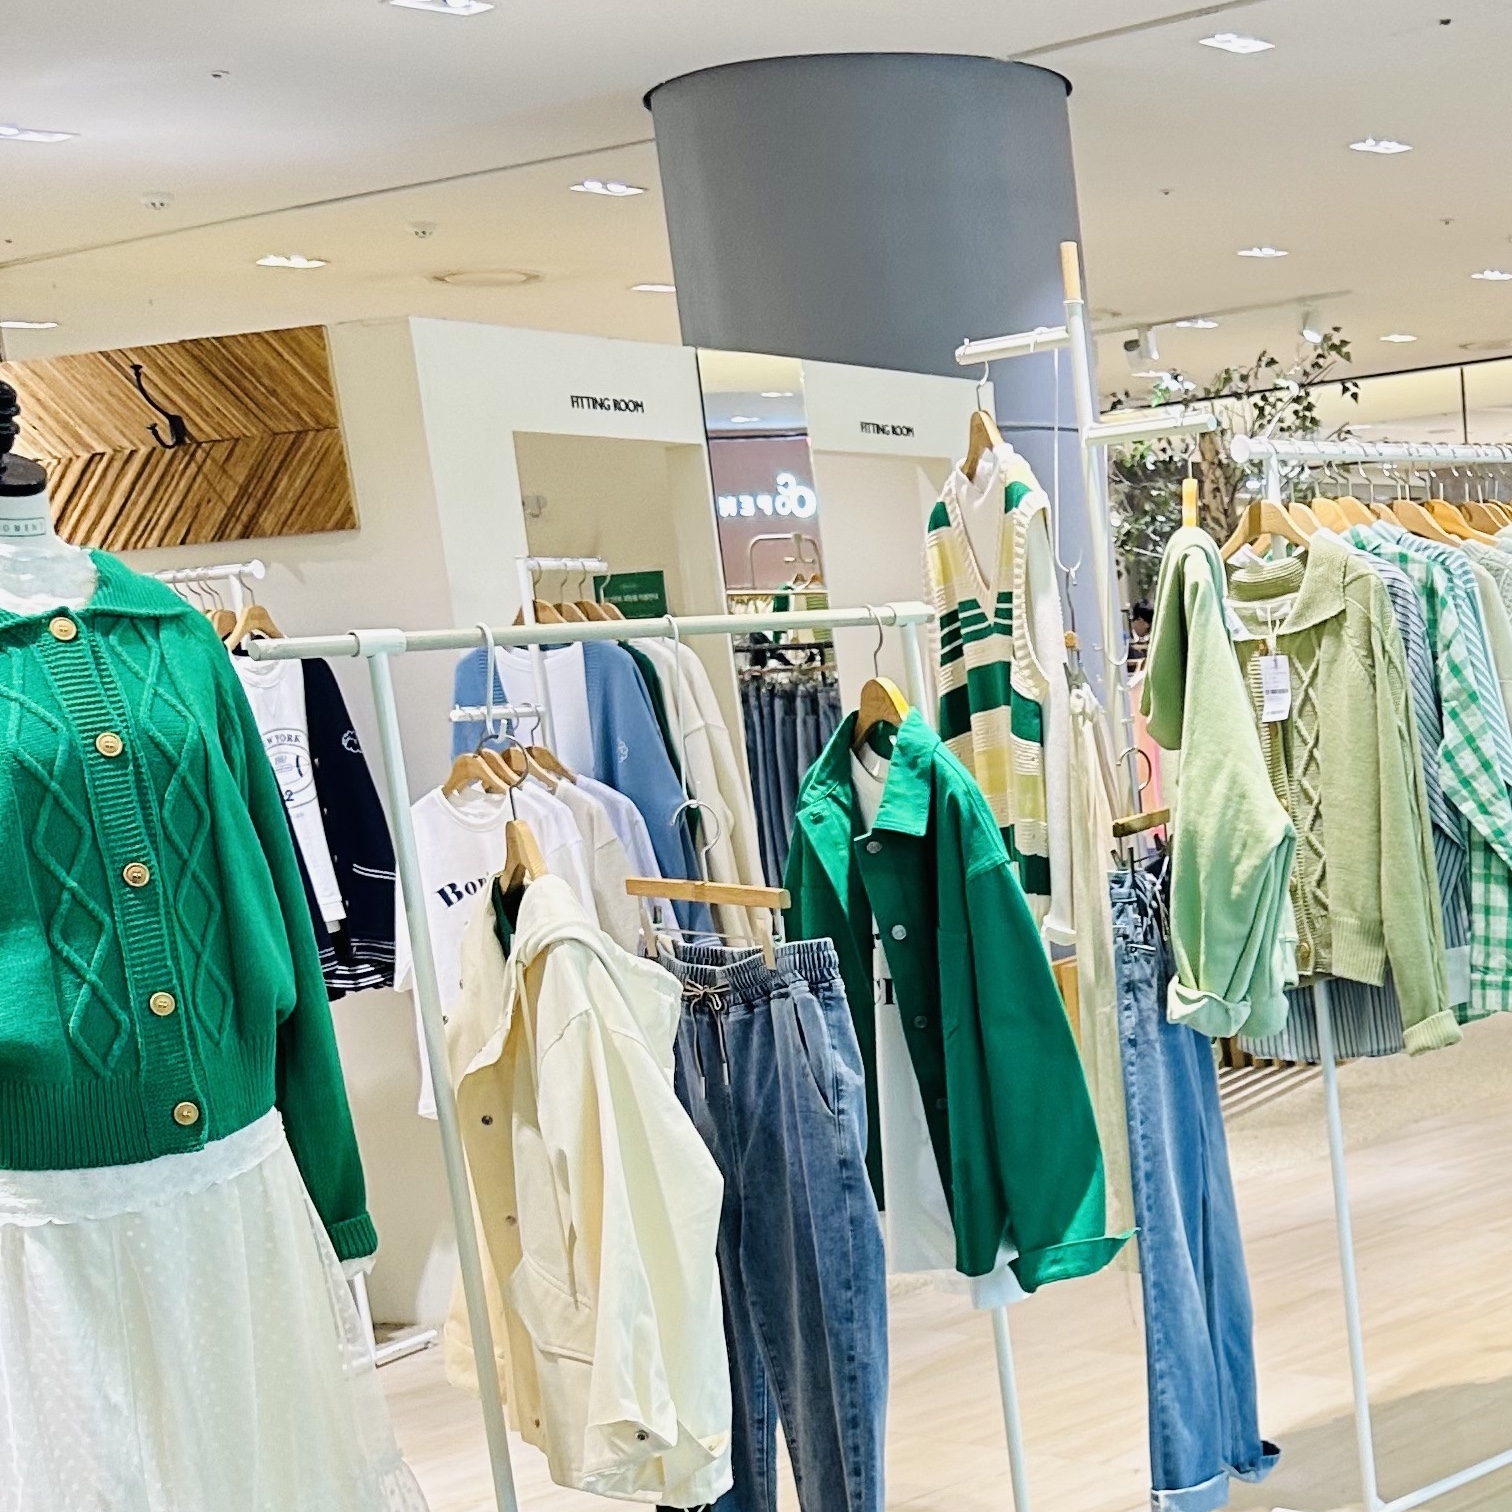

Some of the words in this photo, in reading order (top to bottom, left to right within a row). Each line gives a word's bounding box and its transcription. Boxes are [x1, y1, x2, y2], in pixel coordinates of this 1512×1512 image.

[570, 395, 611, 411] FITTING
[612, 398, 645, 414] ROOM
[860, 421, 890, 436] FITTING
[891, 424, 915, 438] ROOM
[274, 733, 301, 744] YORK
